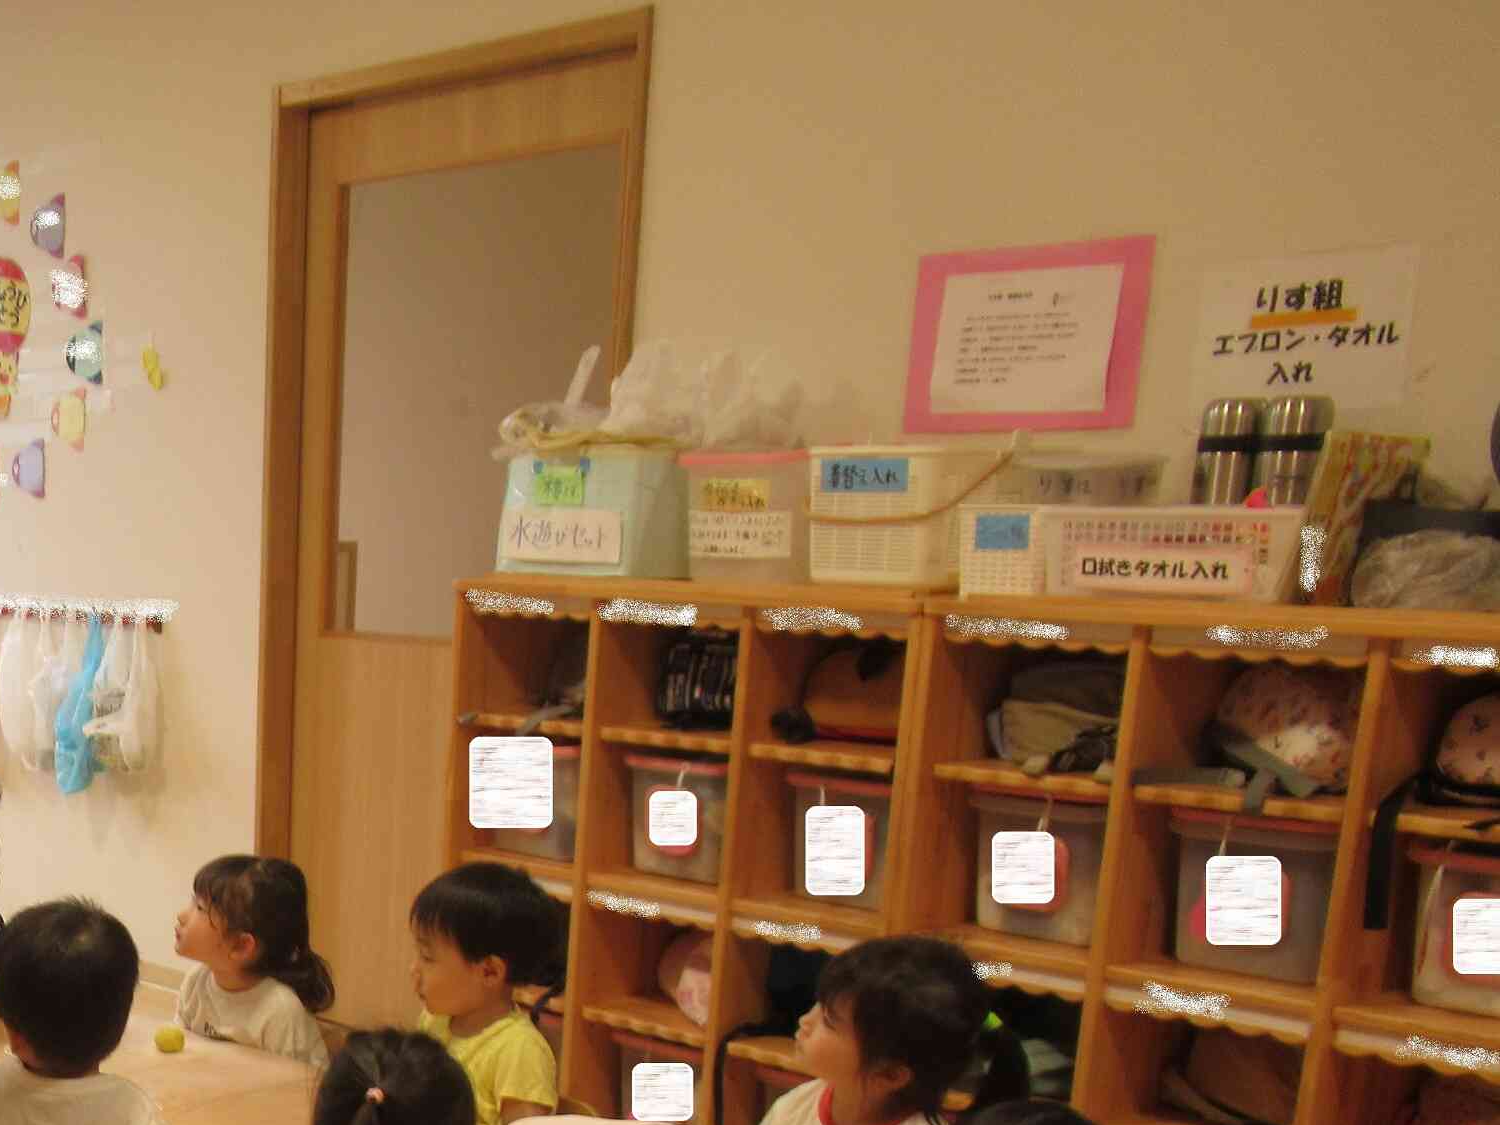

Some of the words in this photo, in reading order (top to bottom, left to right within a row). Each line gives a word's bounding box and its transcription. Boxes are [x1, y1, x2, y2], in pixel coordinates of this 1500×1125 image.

[1256, 279, 1344, 312] りす組
[1267, 361, 1314, 385] 入れ
[1081, 556, 1229, 581] 口拭きタオル入れ
